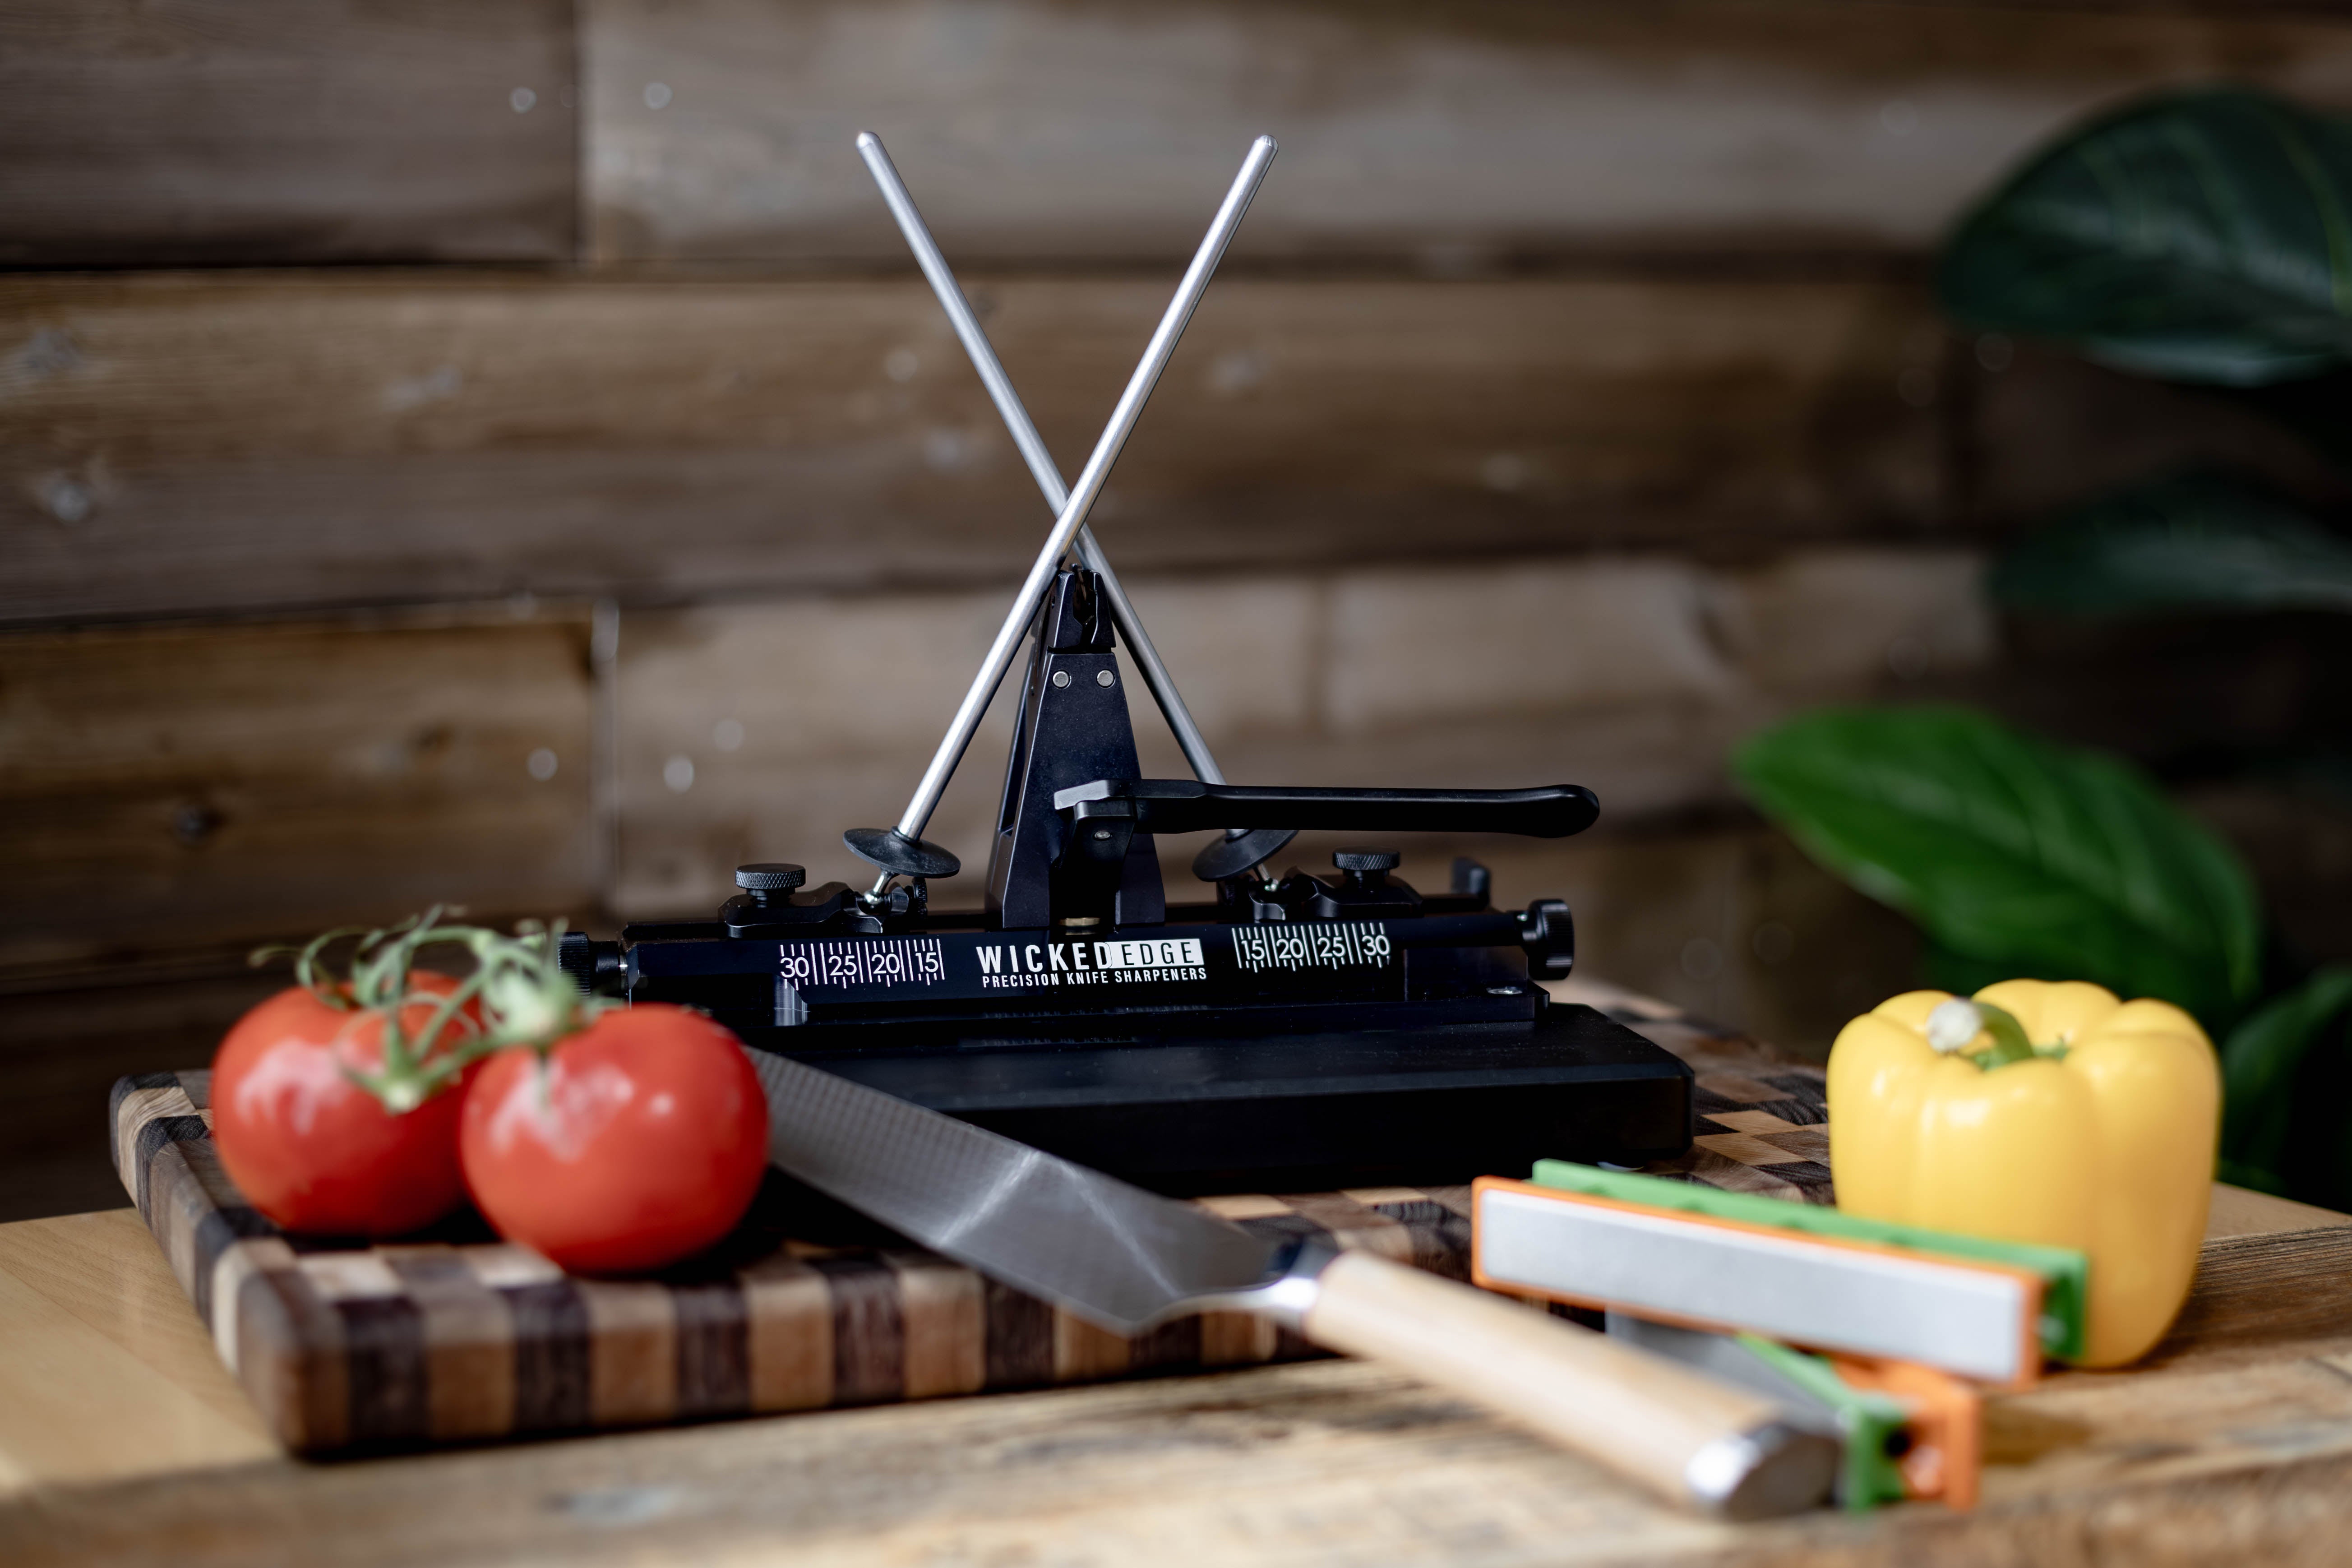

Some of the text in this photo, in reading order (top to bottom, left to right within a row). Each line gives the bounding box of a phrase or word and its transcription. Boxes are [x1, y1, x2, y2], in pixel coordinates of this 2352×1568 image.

[976, 941, 1194, 973] WICKED EDGE
[1241, 935, 1390, 960] 15 20 25 30
[780, 953, 938, 977] 30 25 20 15
[982, 968, 1207, 988] PRECISION KNIFE SHARPENERS
